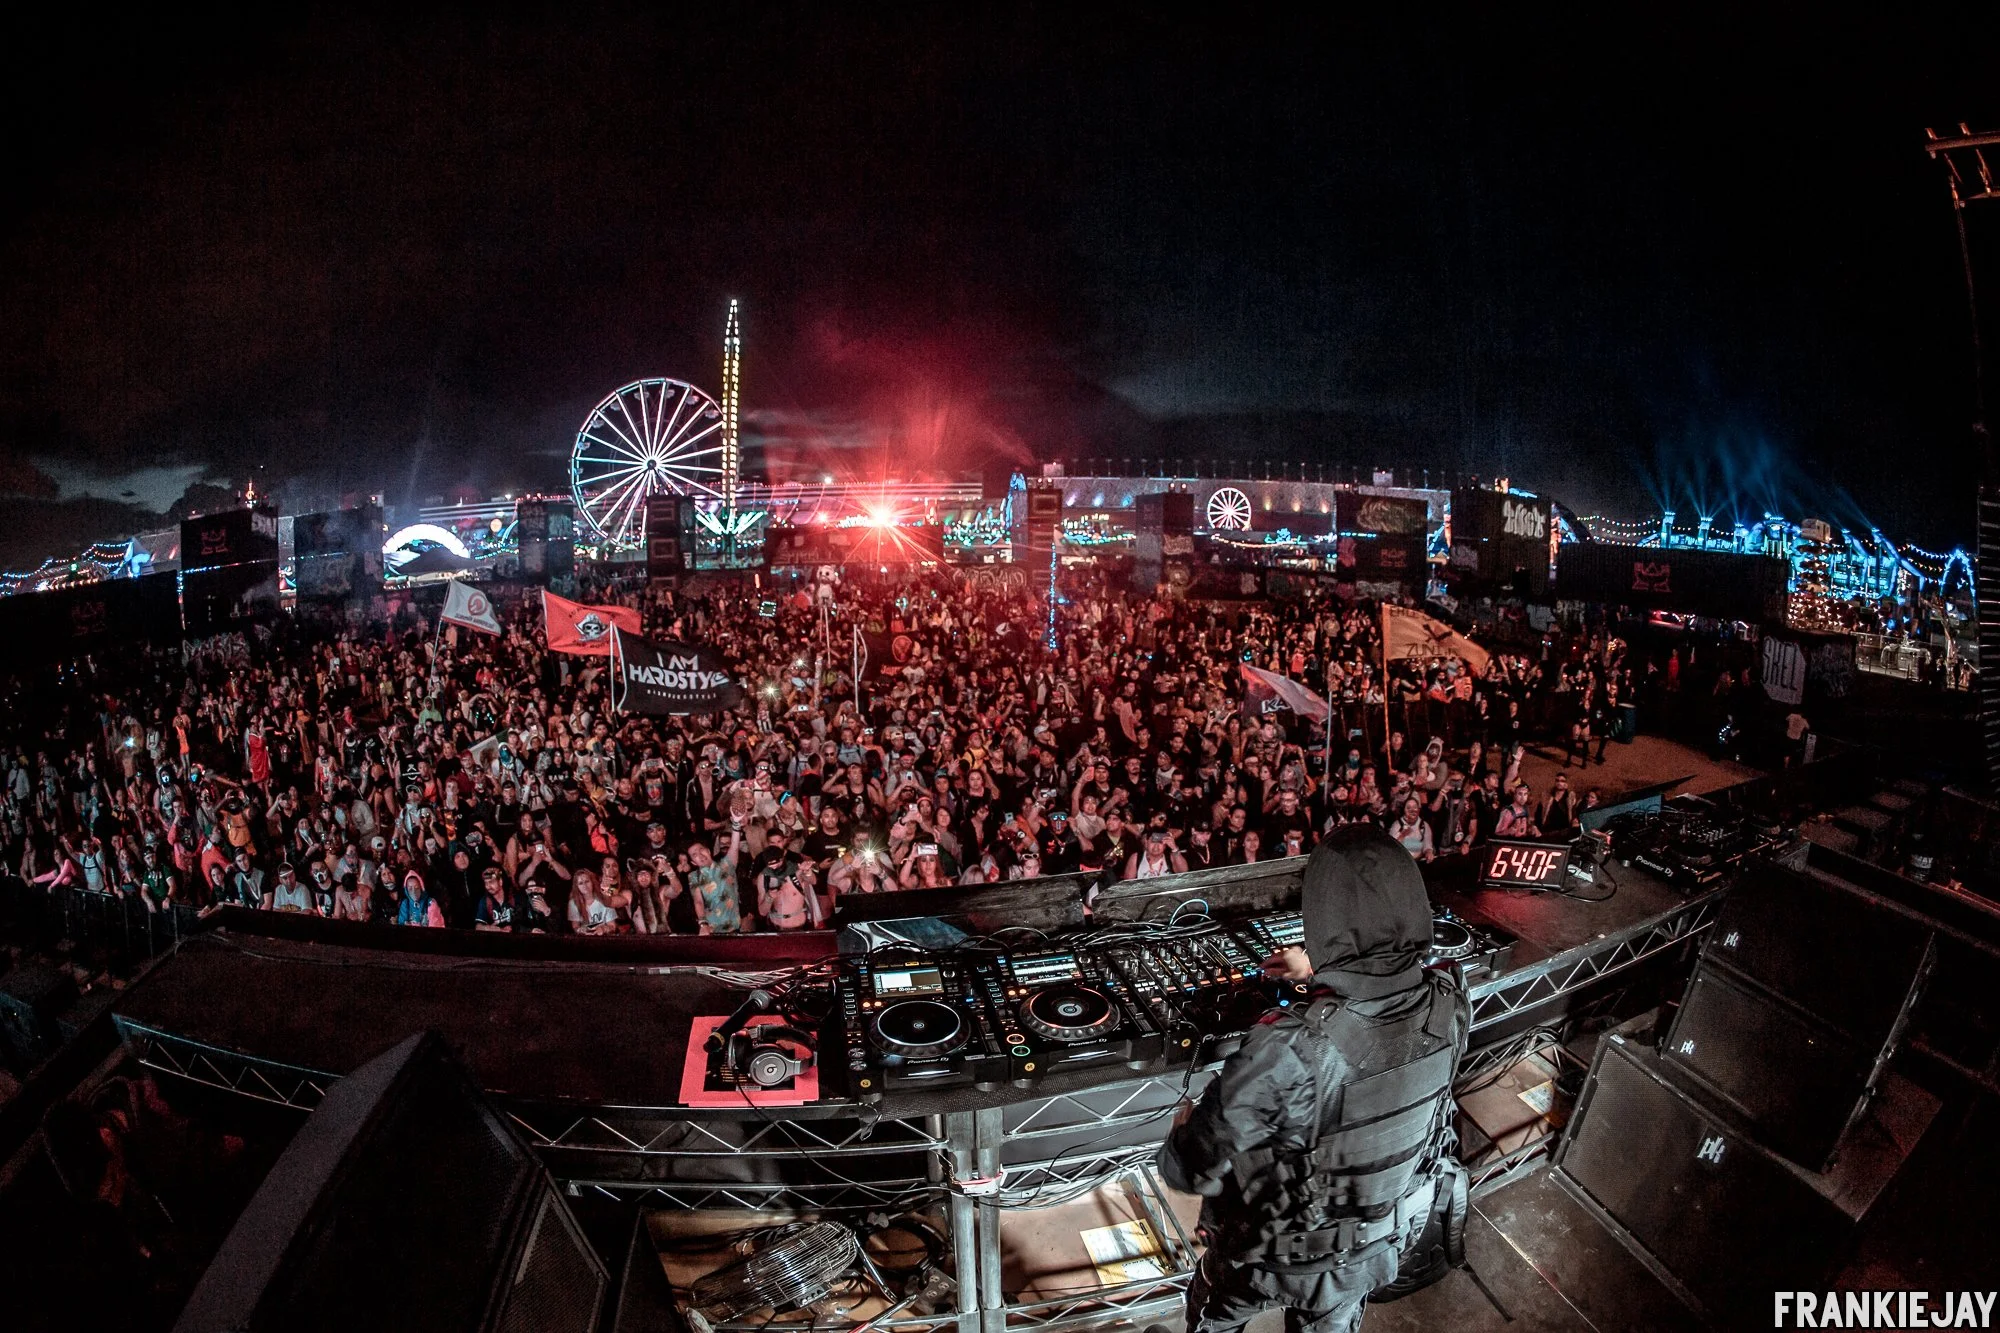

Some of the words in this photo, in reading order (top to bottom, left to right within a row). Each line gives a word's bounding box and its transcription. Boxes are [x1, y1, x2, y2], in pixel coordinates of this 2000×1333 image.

[656, 652, 664, 668] I
[668, 654, 698, 670] AM
[1635, 855, 1664, 871] Pioneer
[1202, 1030, 1248, 1044] Pione
